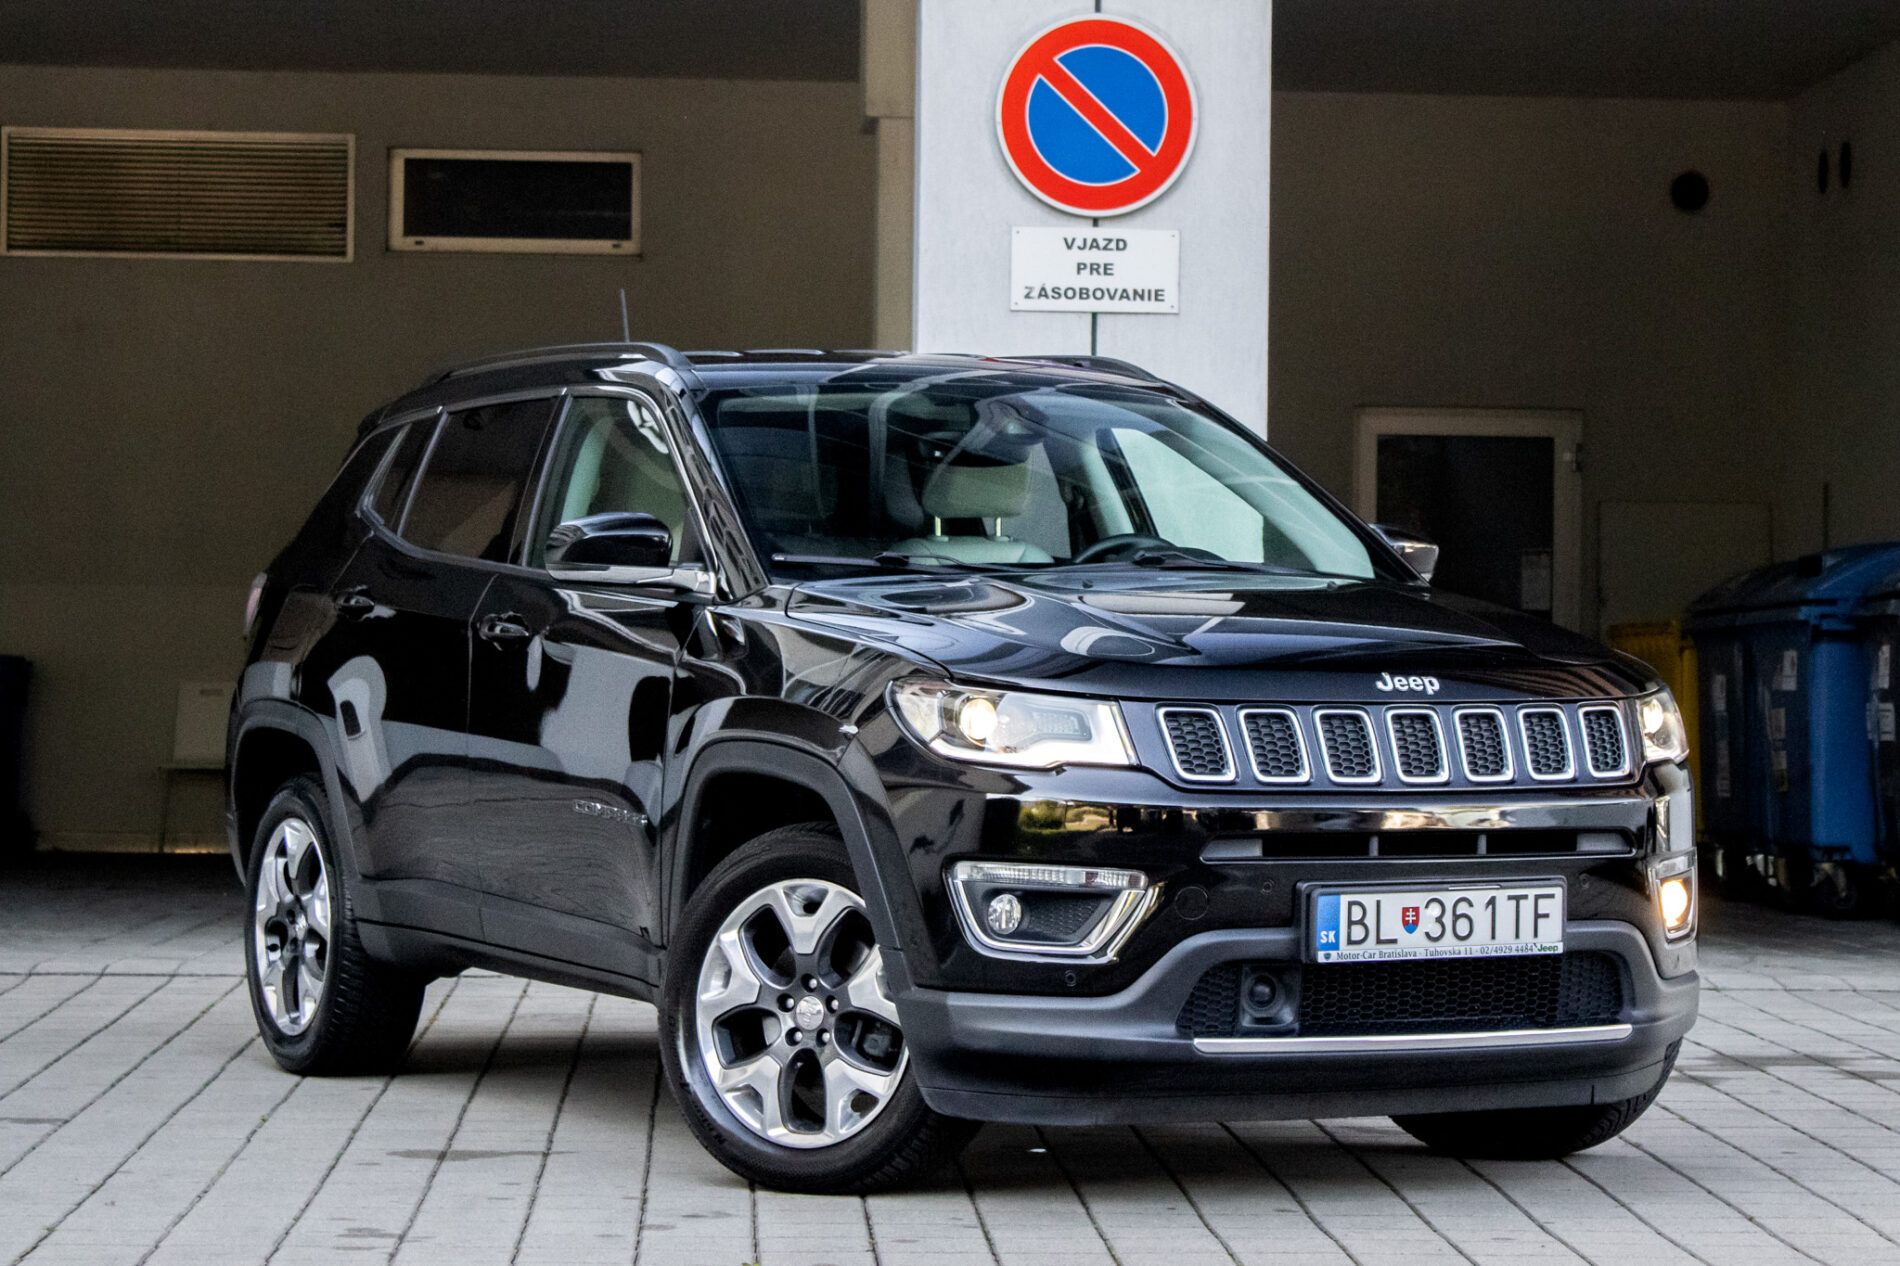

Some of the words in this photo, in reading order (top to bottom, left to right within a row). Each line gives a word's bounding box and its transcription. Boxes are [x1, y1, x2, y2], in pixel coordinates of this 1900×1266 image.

[1063, 237, 1128, 251] VJAZD
[1076, 262, 1114, 276] PRE
[1024, 283, 1166, 302] ZÁSOBOVANIE
[1375, 672, 1440, 695] Jeep
[1346, 899, 1398, 946] BL
[1424, 893, 1556, 943] 361TF
[1320, 930, 1336, 943] SK
[1378, 948, 1417, 959] Bratislava
[1464, 947, 1473, 955] 11
[1480, 945, 1513, 955] 02/4929
[1537, 944, 1559, 953] Jeep
